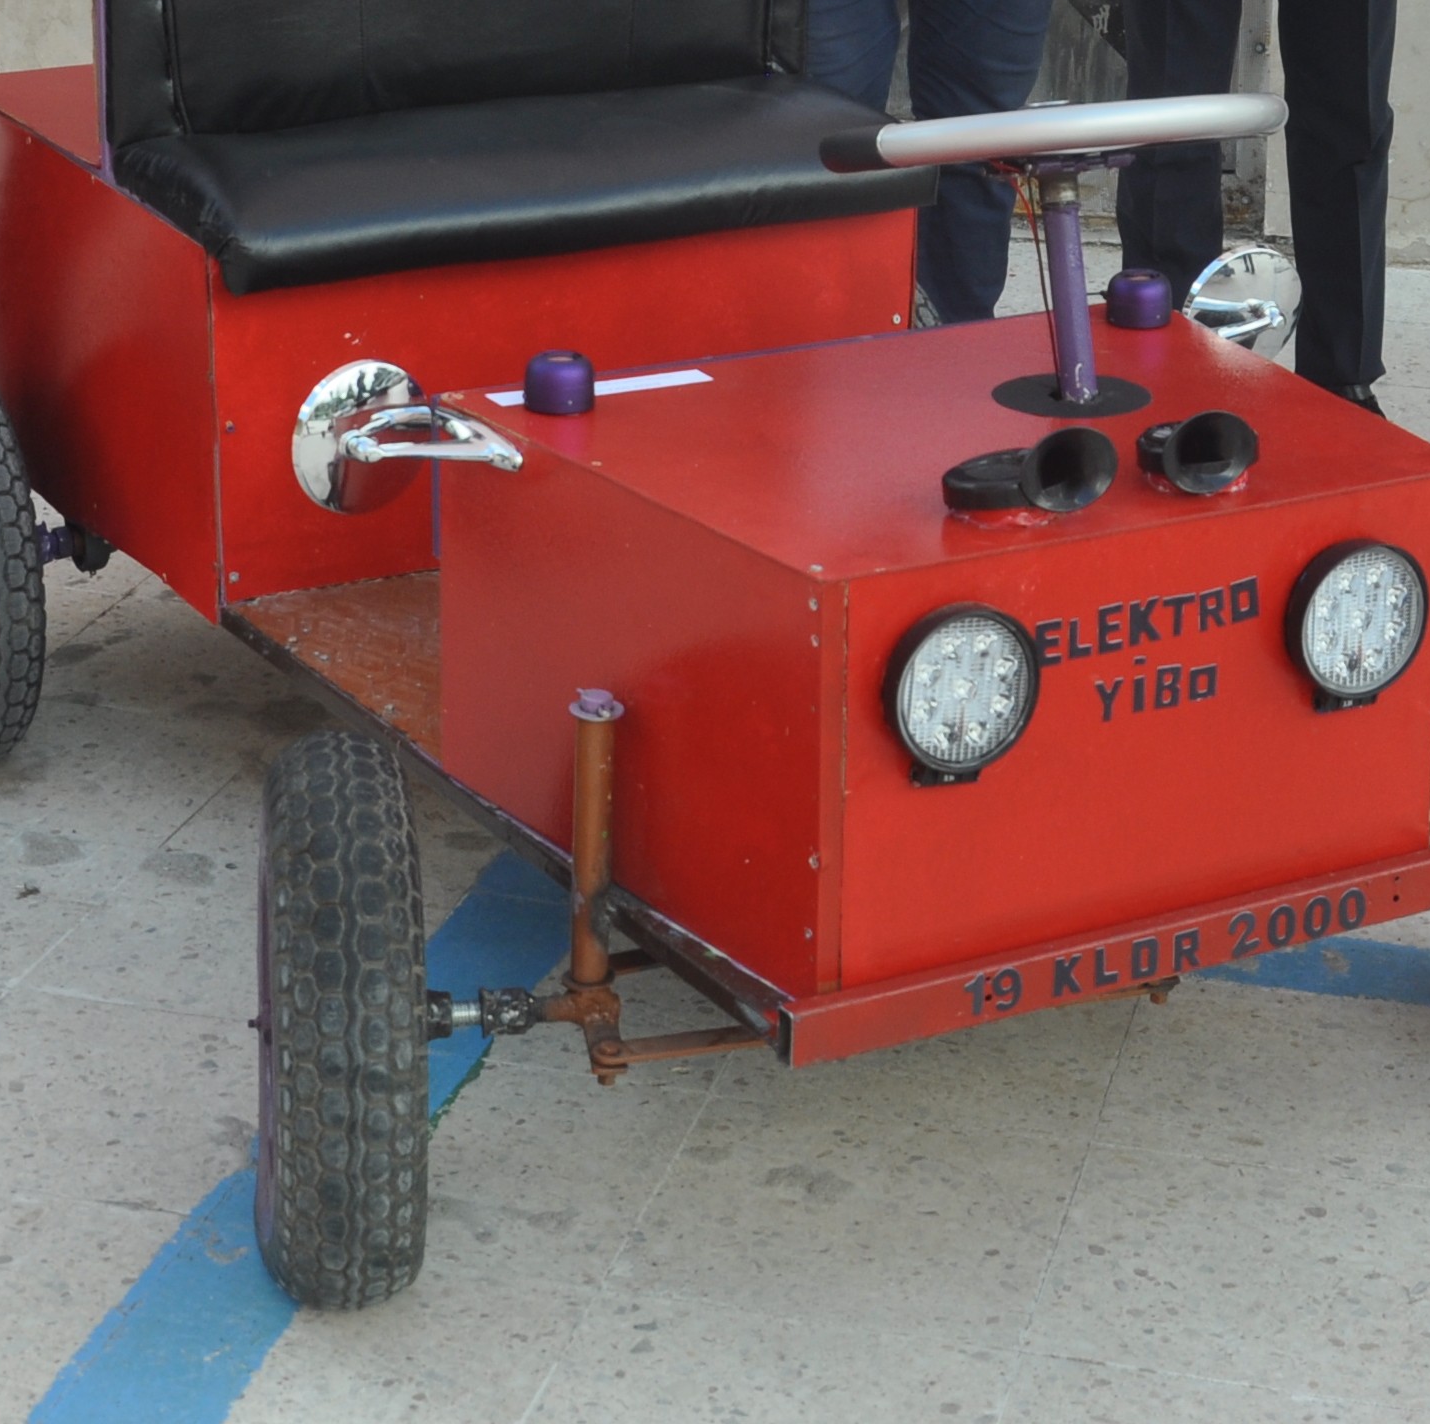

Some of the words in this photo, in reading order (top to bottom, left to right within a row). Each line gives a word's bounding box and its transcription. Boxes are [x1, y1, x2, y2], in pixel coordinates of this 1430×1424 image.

[1034, 575, 1260, 668] ELEKTRO
[962, 966, 1023, 1016] 19
[1227, 886, 1368, 959] 2000
